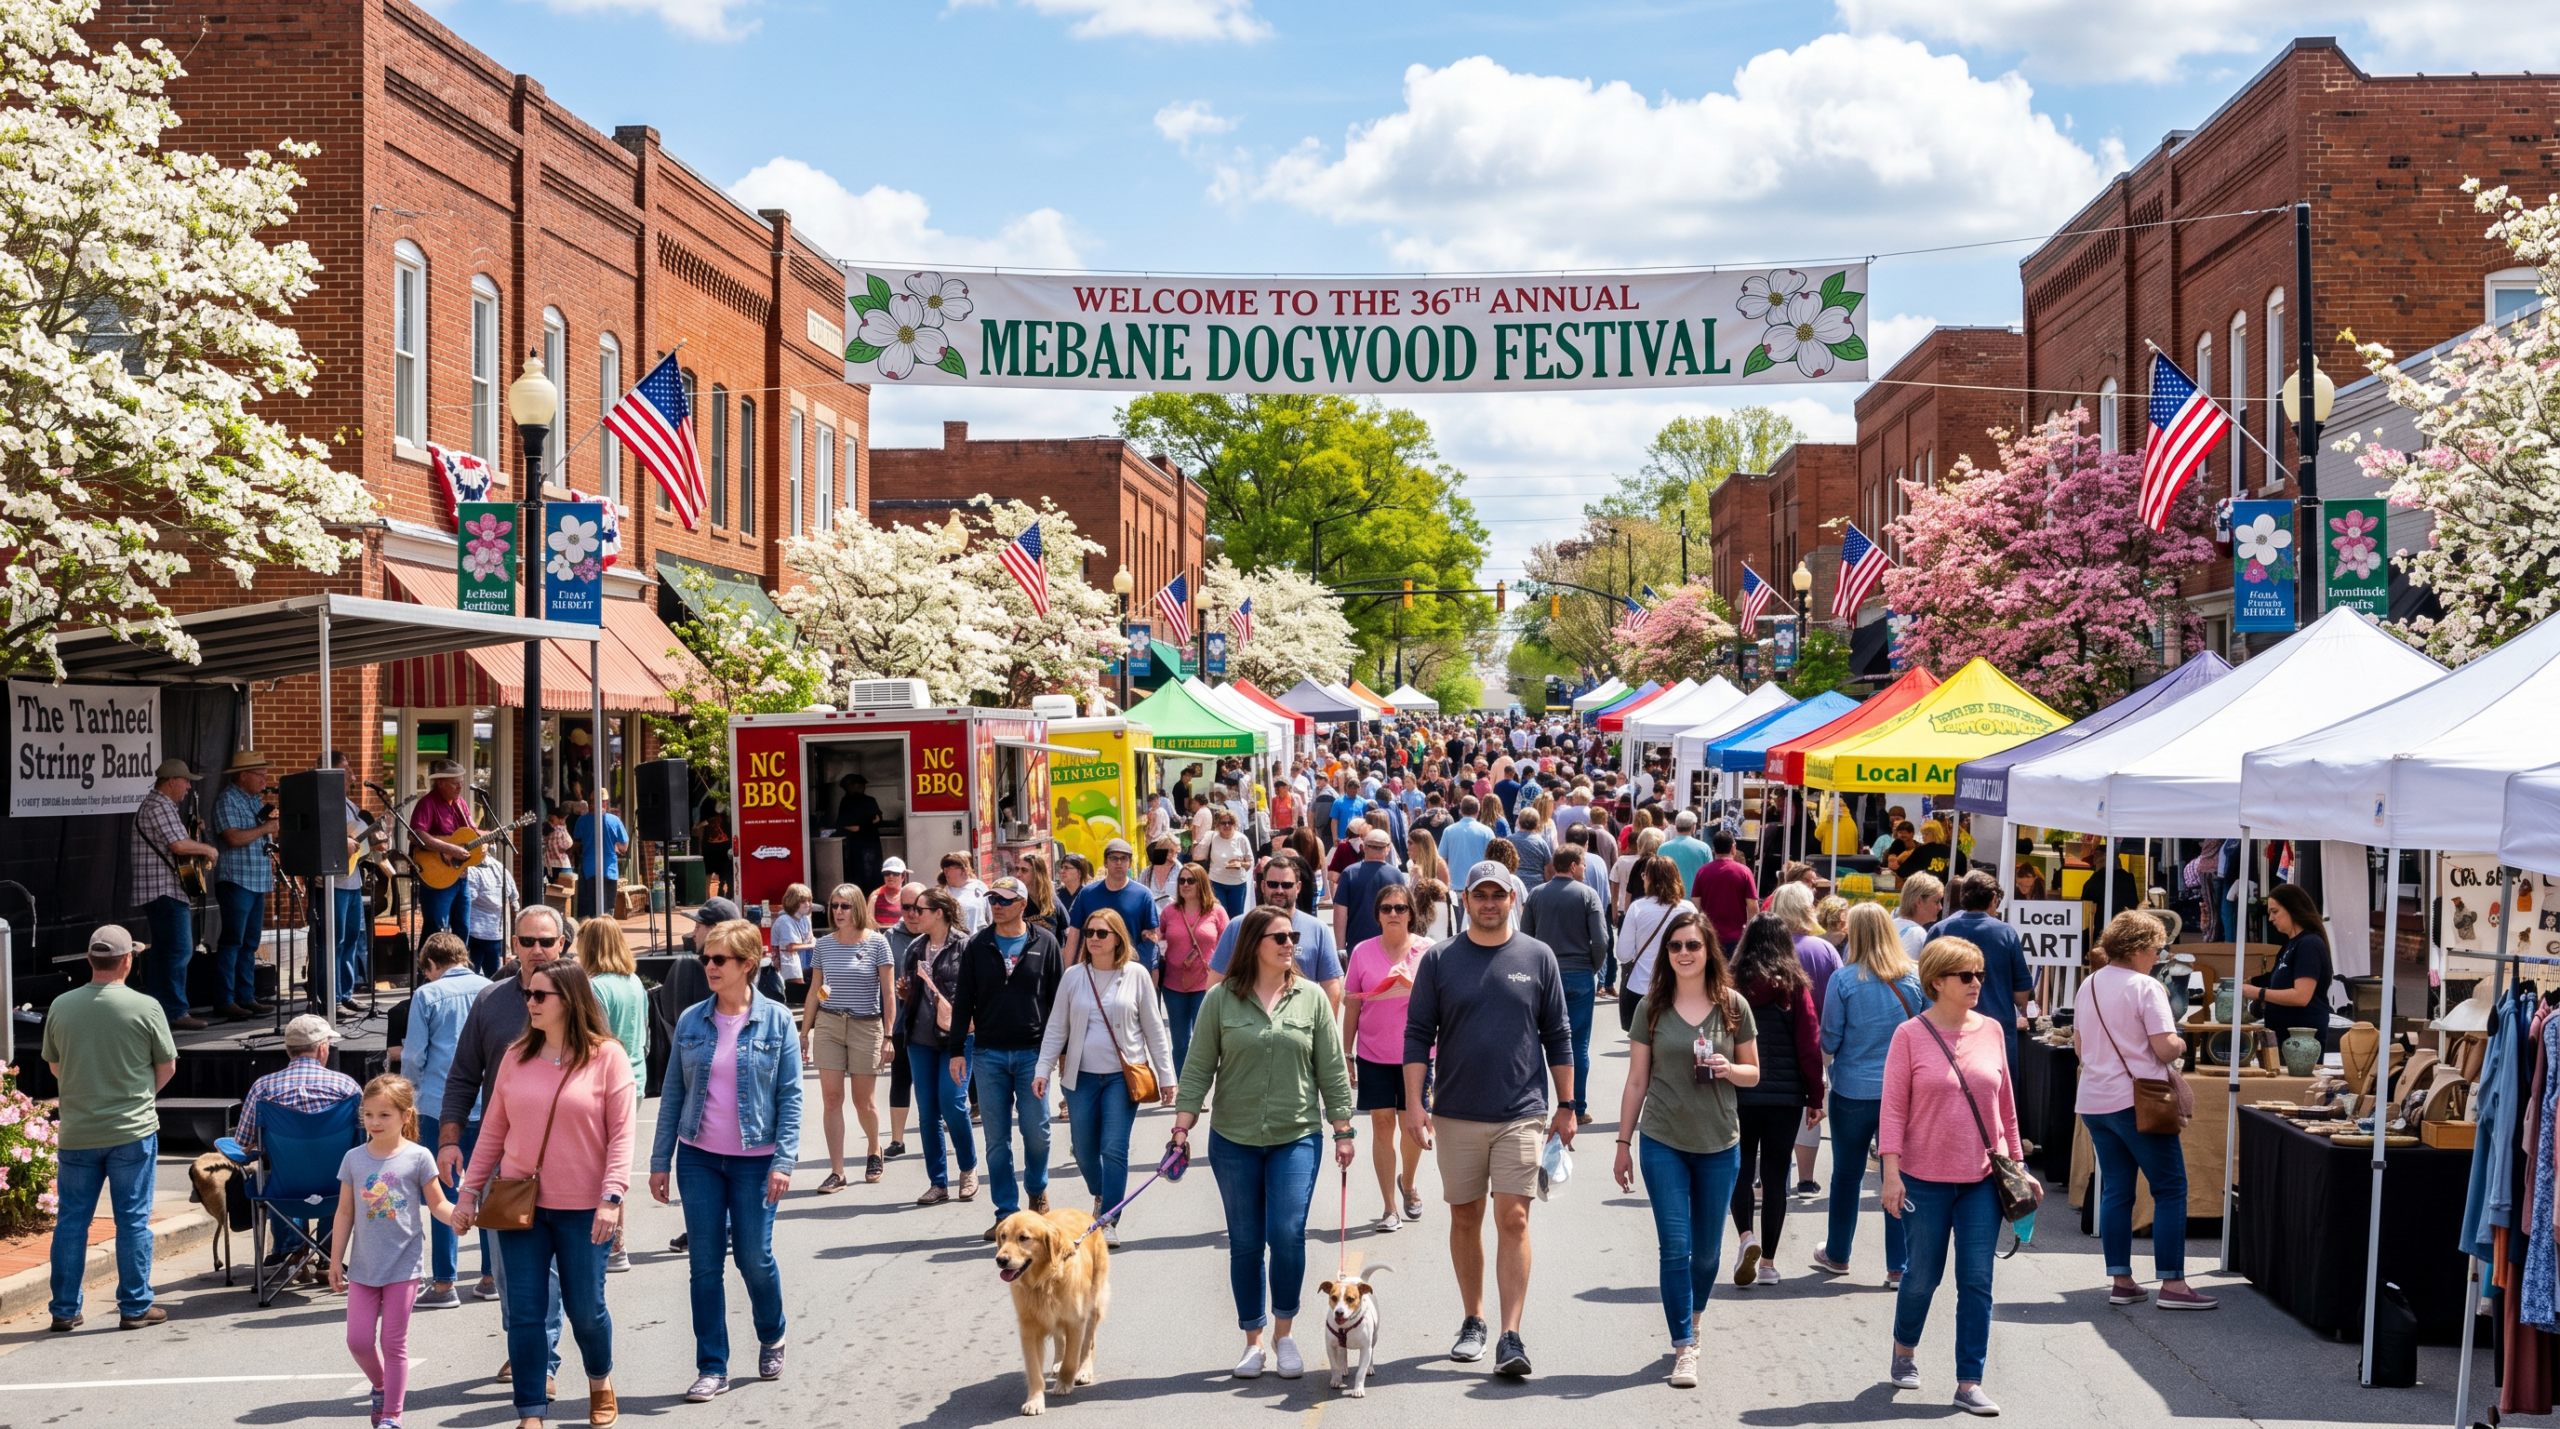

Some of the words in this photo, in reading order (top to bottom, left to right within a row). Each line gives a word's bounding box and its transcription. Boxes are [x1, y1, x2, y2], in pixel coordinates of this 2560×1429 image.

[1074, 287, 1257, 314] WELCOME
[1269, 290, 1317, 315] TO
[1330, 290, 1399, 315] THE
[1411, 287, 1480, 315] 36TH
[1489, 285, 1640, 314] ANNUAL
[980, 319, 1191, 381] MEBANE
[1206, 325, 1477, 384] DOGWOOD
[1493, 318, 1731, 380] FESTIVAL
[18, 696, 64, 734] The
[70, 698, 154, 734] Tarheel
[19, 742, 96, 790] String
[101, 742, 153, 779] Band
[750, 751, 786, 778] NC
[923, 747, 954, 769] NC
[917, 772, 964, 797] BBQ
[1856, 763, 1917, 782] Local
[1925, 764, 1954, 782] Ar
[742, 780, 797, 811] BBQ
[2019, 908, 2071, 926] Local
[2022, 932, 2078, 959] ART
